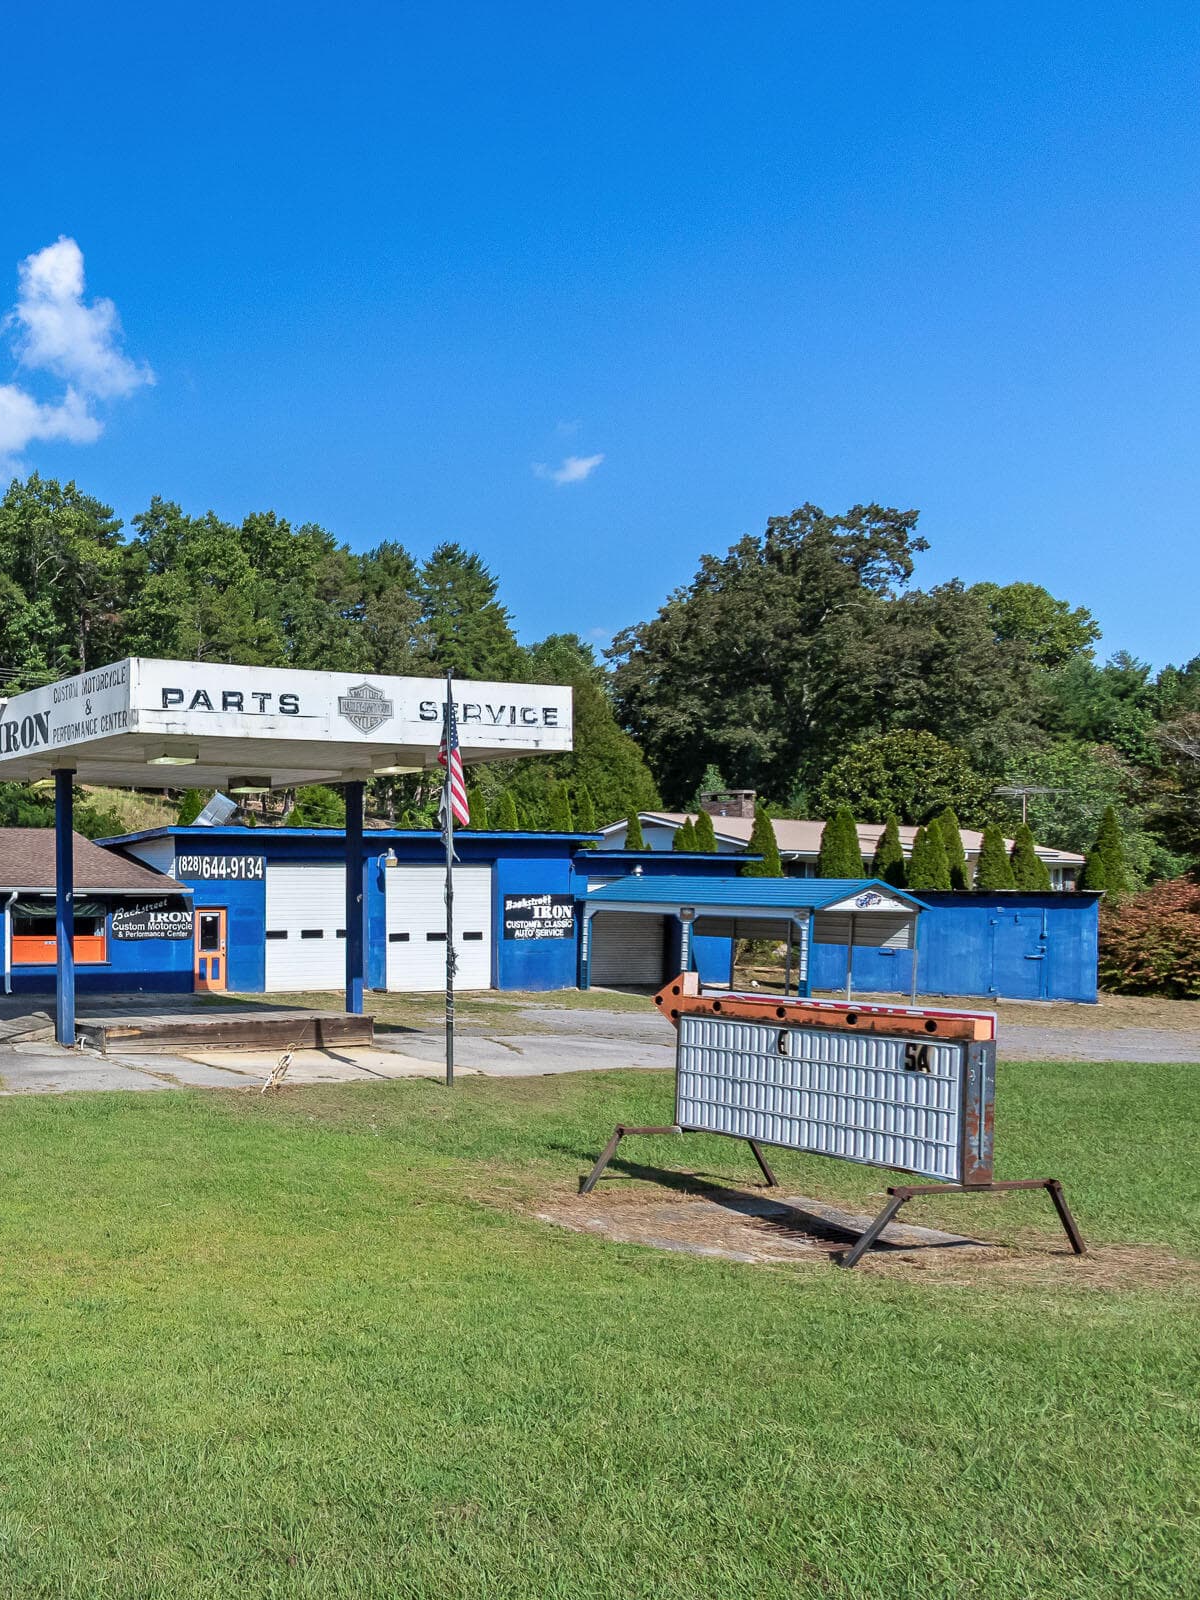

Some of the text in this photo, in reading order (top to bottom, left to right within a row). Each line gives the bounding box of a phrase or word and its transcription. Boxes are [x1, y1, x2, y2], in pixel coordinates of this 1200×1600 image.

[53, 666, 127, 704] CUSTOM MOTORCYCLE
[84, 699, 93, 715] &
[161, 687, 300, 715] PARTS
[418, 700, 559, 727] SERVICE
[52, 718, 98, 744] PERFORMANCE
[100, 710, 128, 733] CENTER
[112, 897, 169, 922] Backstreet
[149, 911, 193, 923] IRON
[532, 905, 574, 919] IRON
[112, 921, 193, 932] Custom Motorcycle
[125, 930, 165, 938] Performance
[167, 930, 189, 938] Center
[514, 928, 564, 938] AUTO SERVICE
